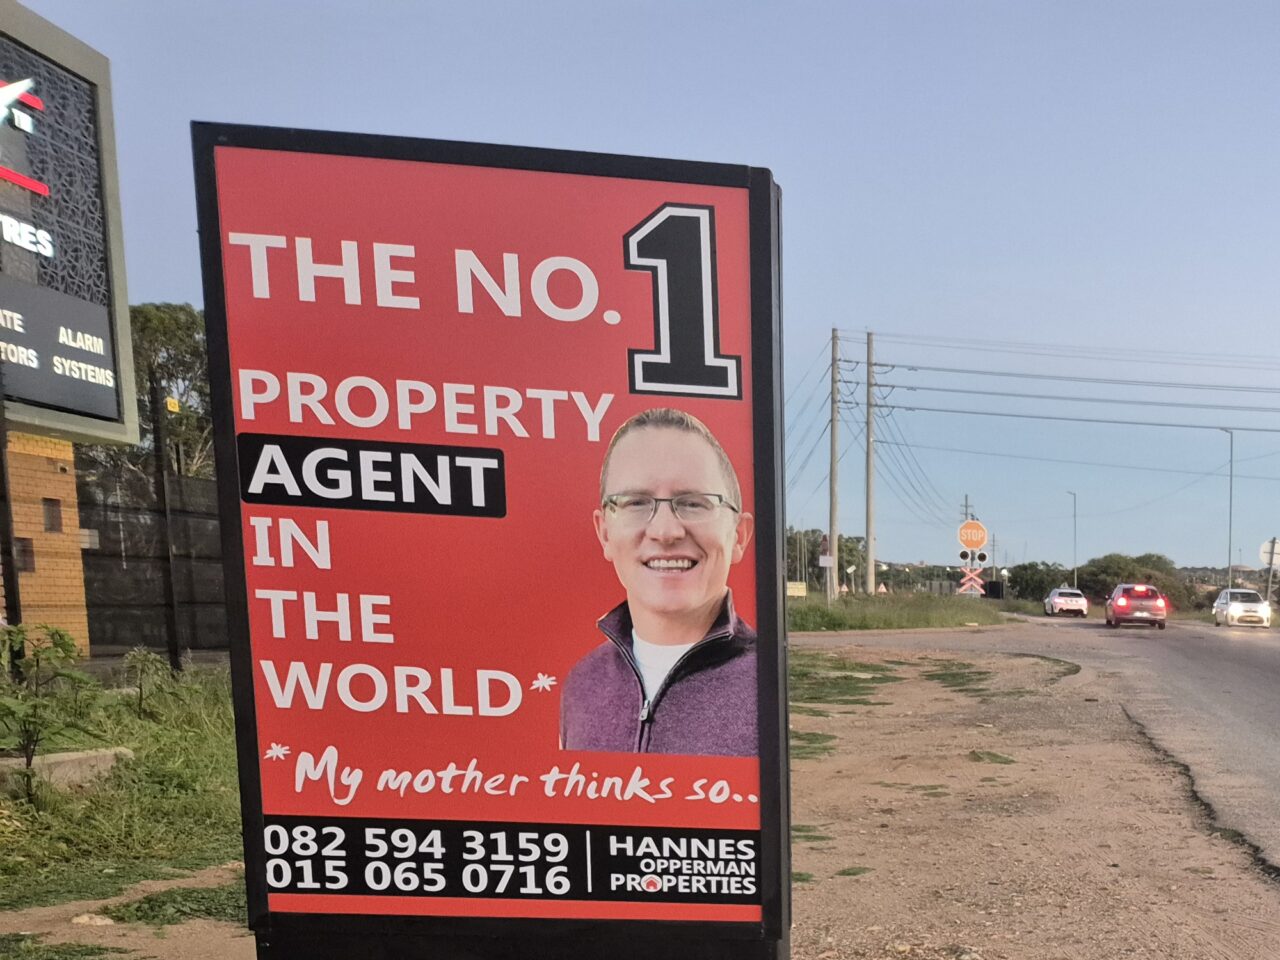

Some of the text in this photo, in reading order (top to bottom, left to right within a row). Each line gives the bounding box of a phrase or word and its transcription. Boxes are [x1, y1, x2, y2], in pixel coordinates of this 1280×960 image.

[0, 214, 54, 257] RES
[229, 201, 742, 400] THE NO. 1
[59, 326, 104, 355] ALARM
[53, 356, 114, 388] SYSTEMS
[238, 368, 615, 443] PROPERTY
[248, 444, 498, 507] AGENT
[249, 516, 332, 570] IN
[961, 529, 984, 540] STOP
[255, 589, 394, 644] THE
[377, 758, 529, 799] mother
[540, 761, 675, 804] thinks
[264, 824, 569, 863] 082 594 3159
[609, 835, 756, 859] HANNES
[265, 858, 571, 895] 015 065 0716
[610, 873, 757, 894] PROPERTIES
[640, 858, 756, 876] OPPERMAN
